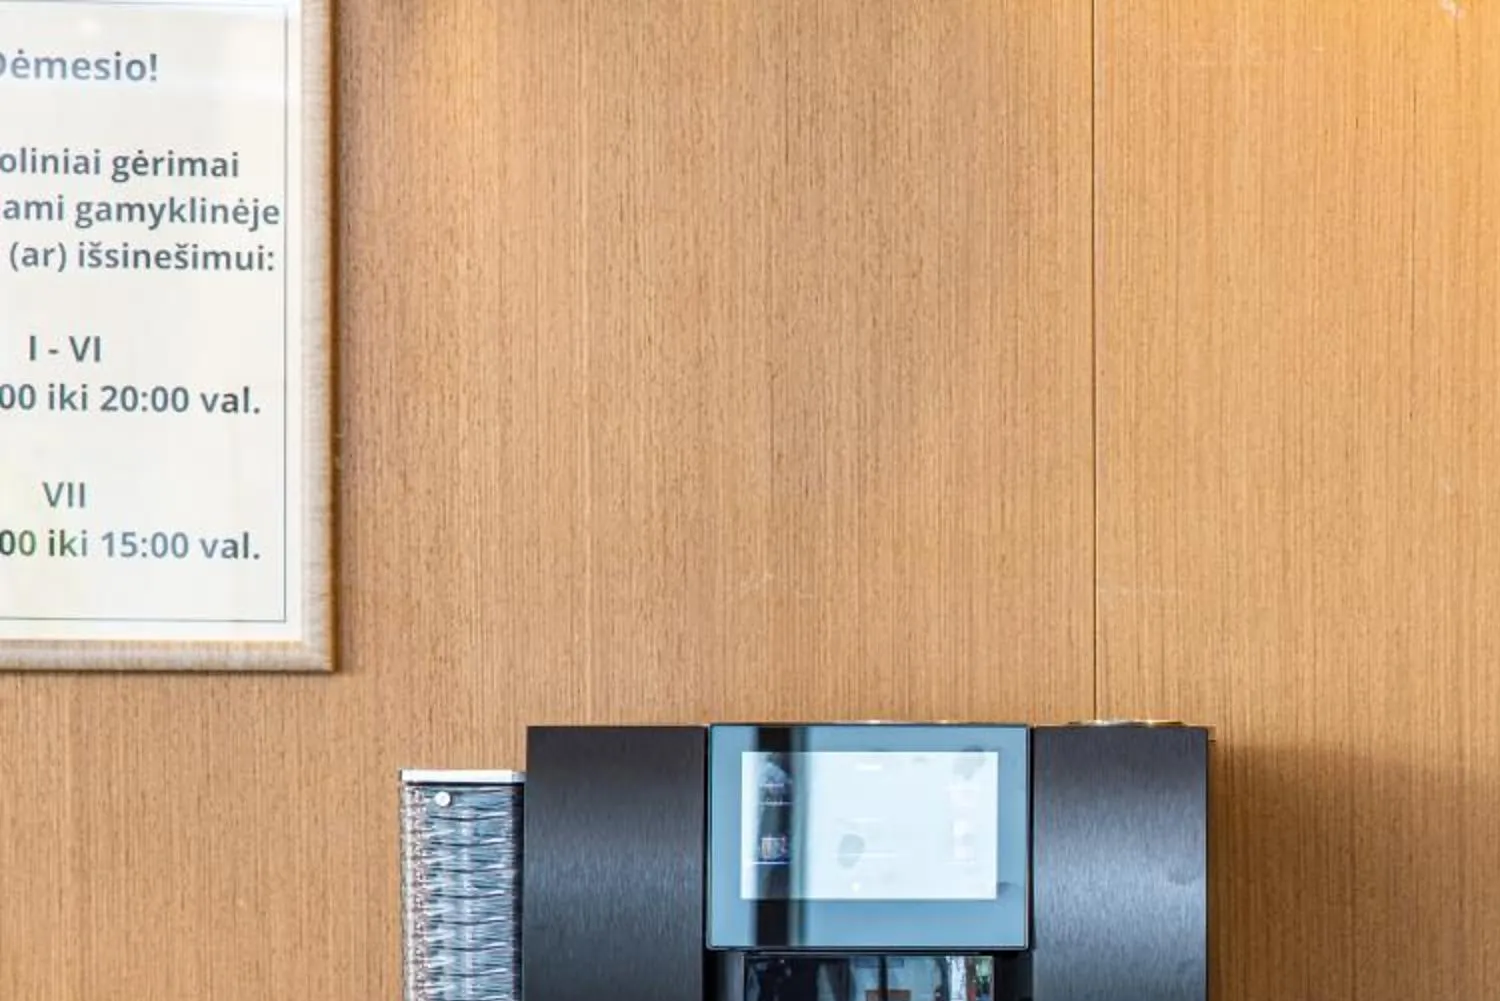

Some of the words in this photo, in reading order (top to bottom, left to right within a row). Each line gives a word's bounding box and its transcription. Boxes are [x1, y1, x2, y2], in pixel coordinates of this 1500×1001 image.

[0, 147, 101, 176] oliniai
[111, 149, 240, 184] gėrimai
[2, 194, 65, 221] ami
[75, 196, 280, 233] gamyklinėje
[9, 242, 67, 273] (ar)
[78, 242, 275, 272] išsinešimui:
[69, 335, 101, 363] VI
[0, 384, 37, 411] 00
[48, 383, 88, 412] iki
[100, 385, 190, 413] 20:00
[200, 386, 261, 415] val.
[42, 482, 86, 509] VII
[0, 529, 37, 557] 00
[48, 529, 88, 558] iki
[101, 531, 190, 559] 15:00
[200, 532, 261, 560] val.
